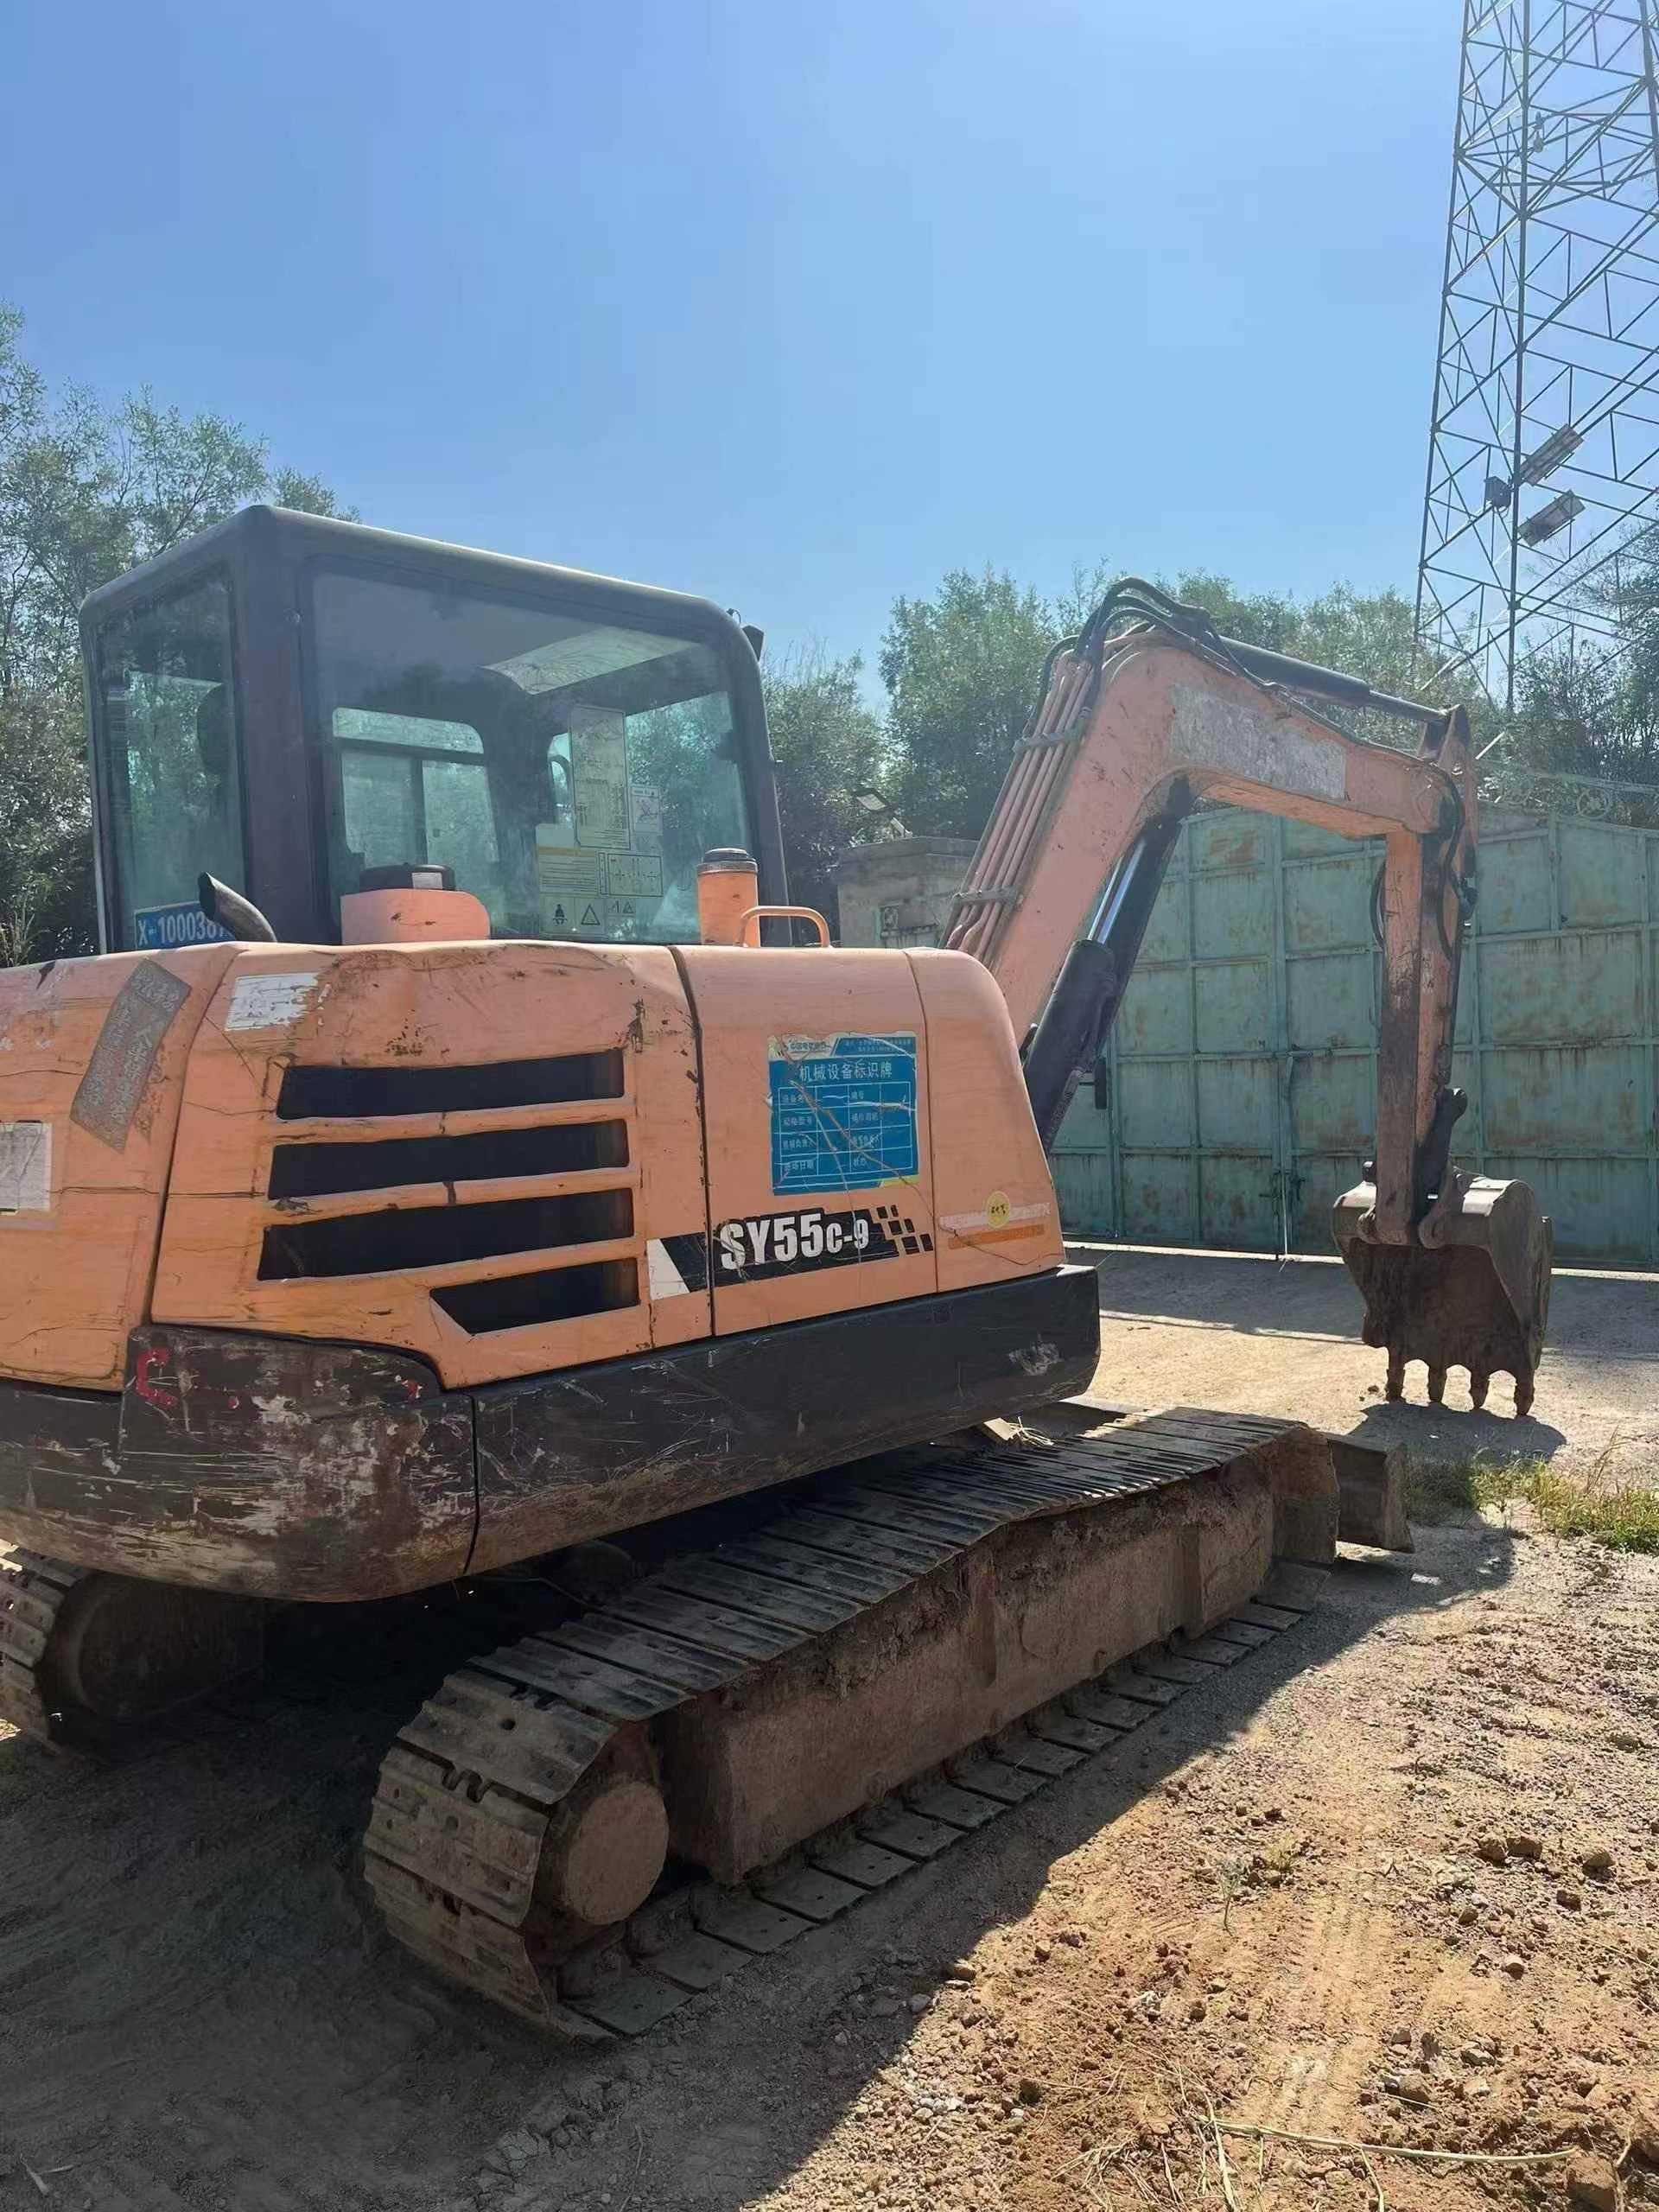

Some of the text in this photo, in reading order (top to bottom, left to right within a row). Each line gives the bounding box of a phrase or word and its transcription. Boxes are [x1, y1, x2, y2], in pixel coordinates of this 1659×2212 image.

[800, 1060, 893, 1081] 机械设备标识牌
